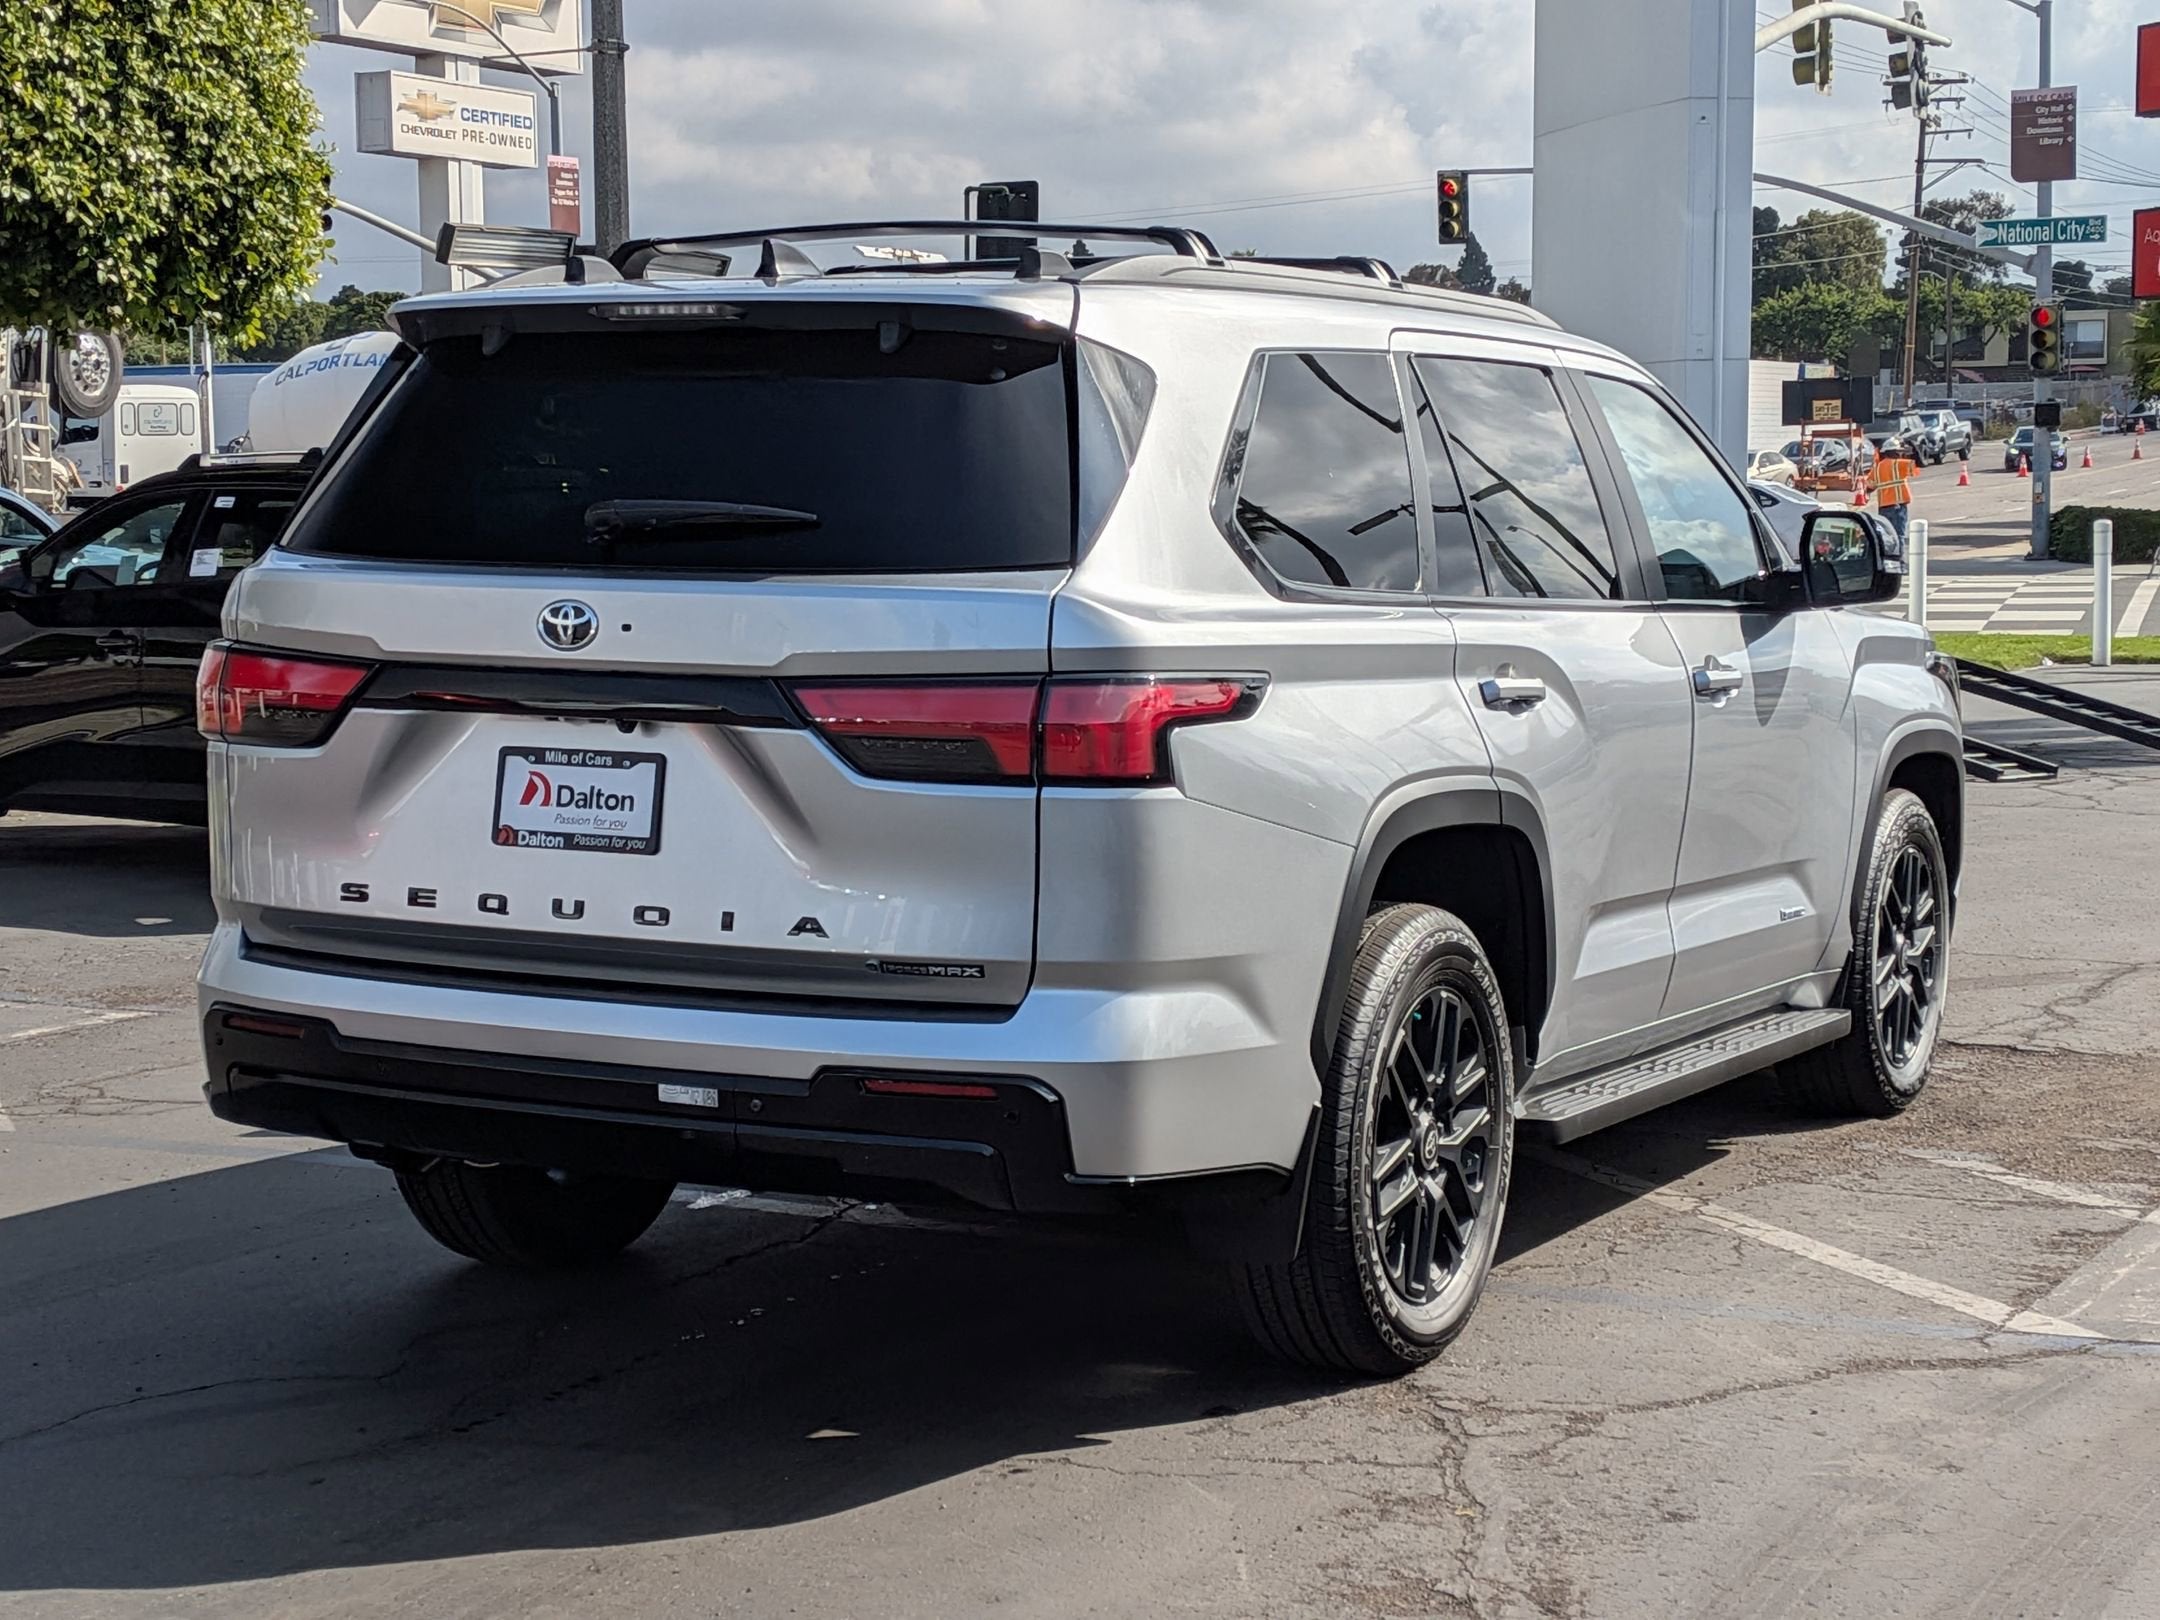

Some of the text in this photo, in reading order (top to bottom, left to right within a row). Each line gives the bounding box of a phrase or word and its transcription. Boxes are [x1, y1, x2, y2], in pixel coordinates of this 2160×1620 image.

[460, 107, 533, 130] CERTIFIED
[400, 123, 457, 140] CHEVROLET
[462, 128, 532, 150] PRE-OWNED
[1998, 219, 2086, 244] National City
[545, 751, 613, 766] Mile of Cars
[556, 784, 635, 812] Dalton
[554, 813, 628, 830] Passion for you
[518, 830, 646, 851] Dalton Passion for you
[340, 882, 831, 939] SEQUOIA
